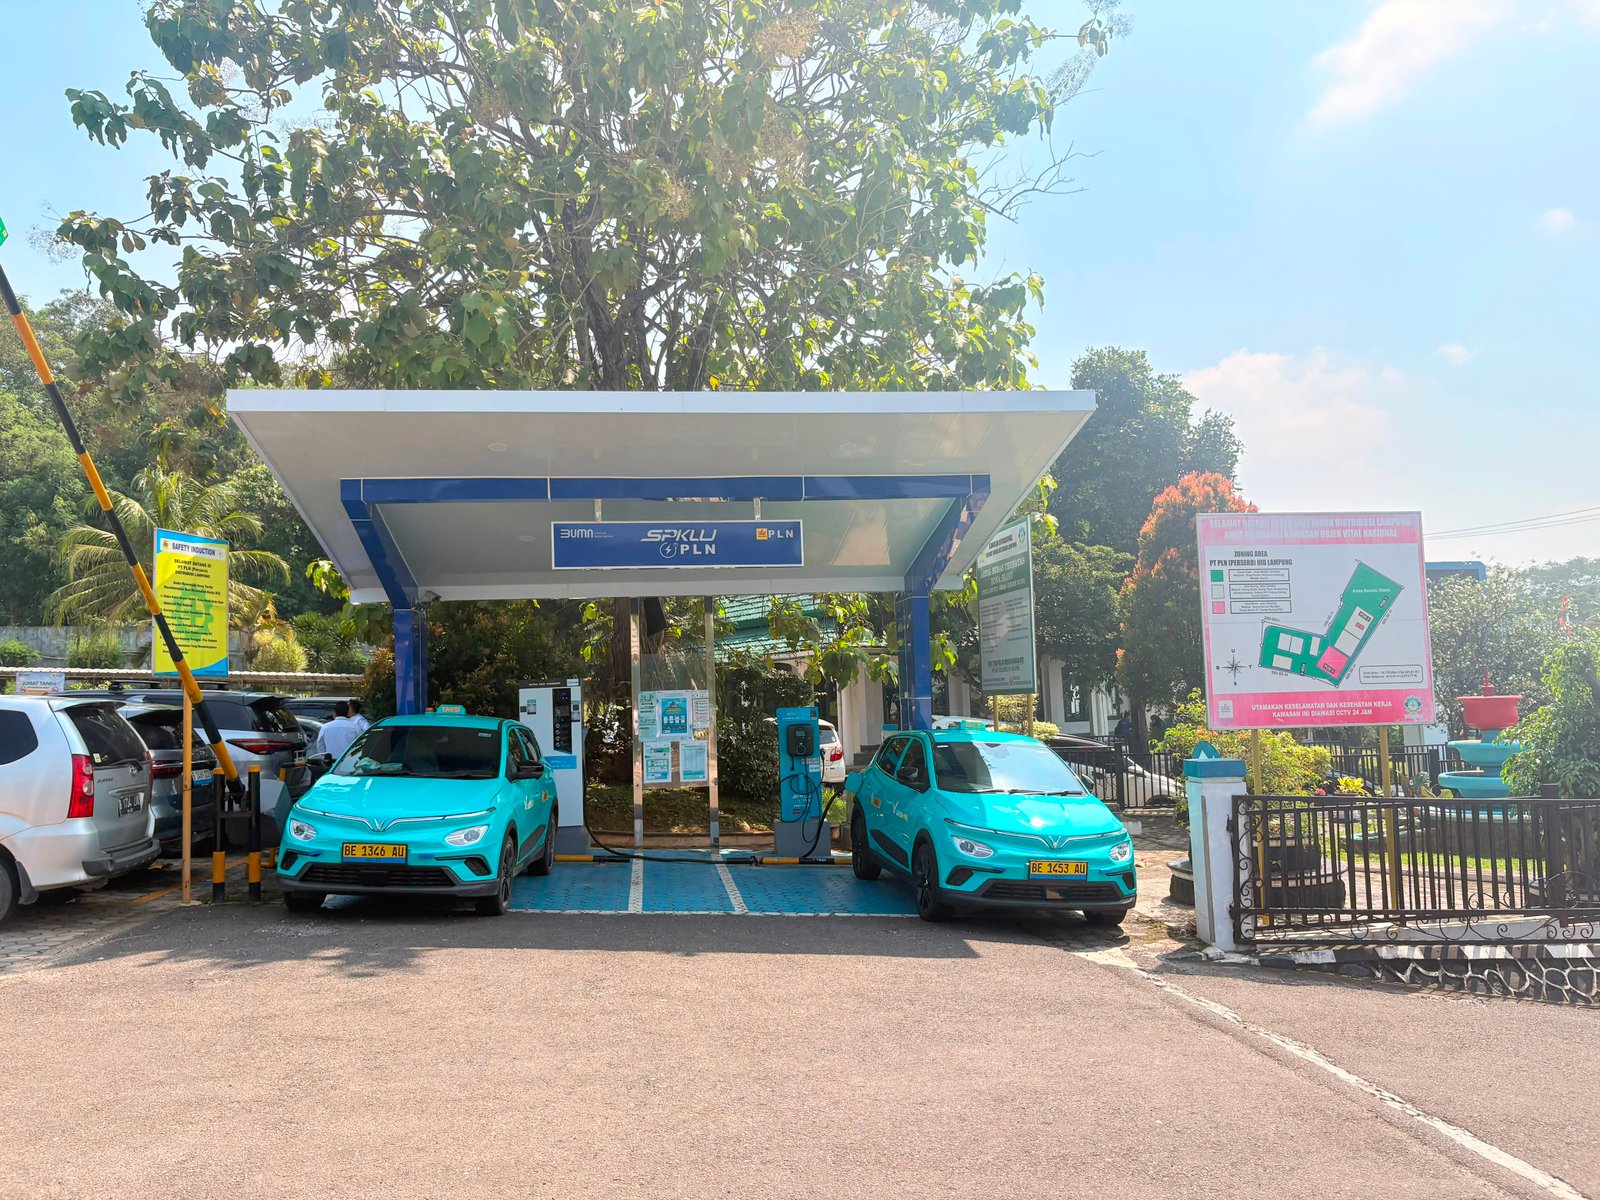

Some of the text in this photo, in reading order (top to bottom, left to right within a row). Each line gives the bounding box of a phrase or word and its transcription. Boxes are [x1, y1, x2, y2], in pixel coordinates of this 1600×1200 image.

[560, 528, 594, 538] BUMN
[640, 529, 718, 542] SPKLU
[768, 530, 794, 538] PLN
[1343, 529, 1362, 538] VITAL
[1363, 529, 1397, 537] NASIONAL
[172, 542, 216, 556] SAFETY INDUCTION
[680, 544, 716, 554] PLN
[344, 846, 404, 857] BE 1346 AU
[1032, 863, 1085, 873] BE 1453 AU
